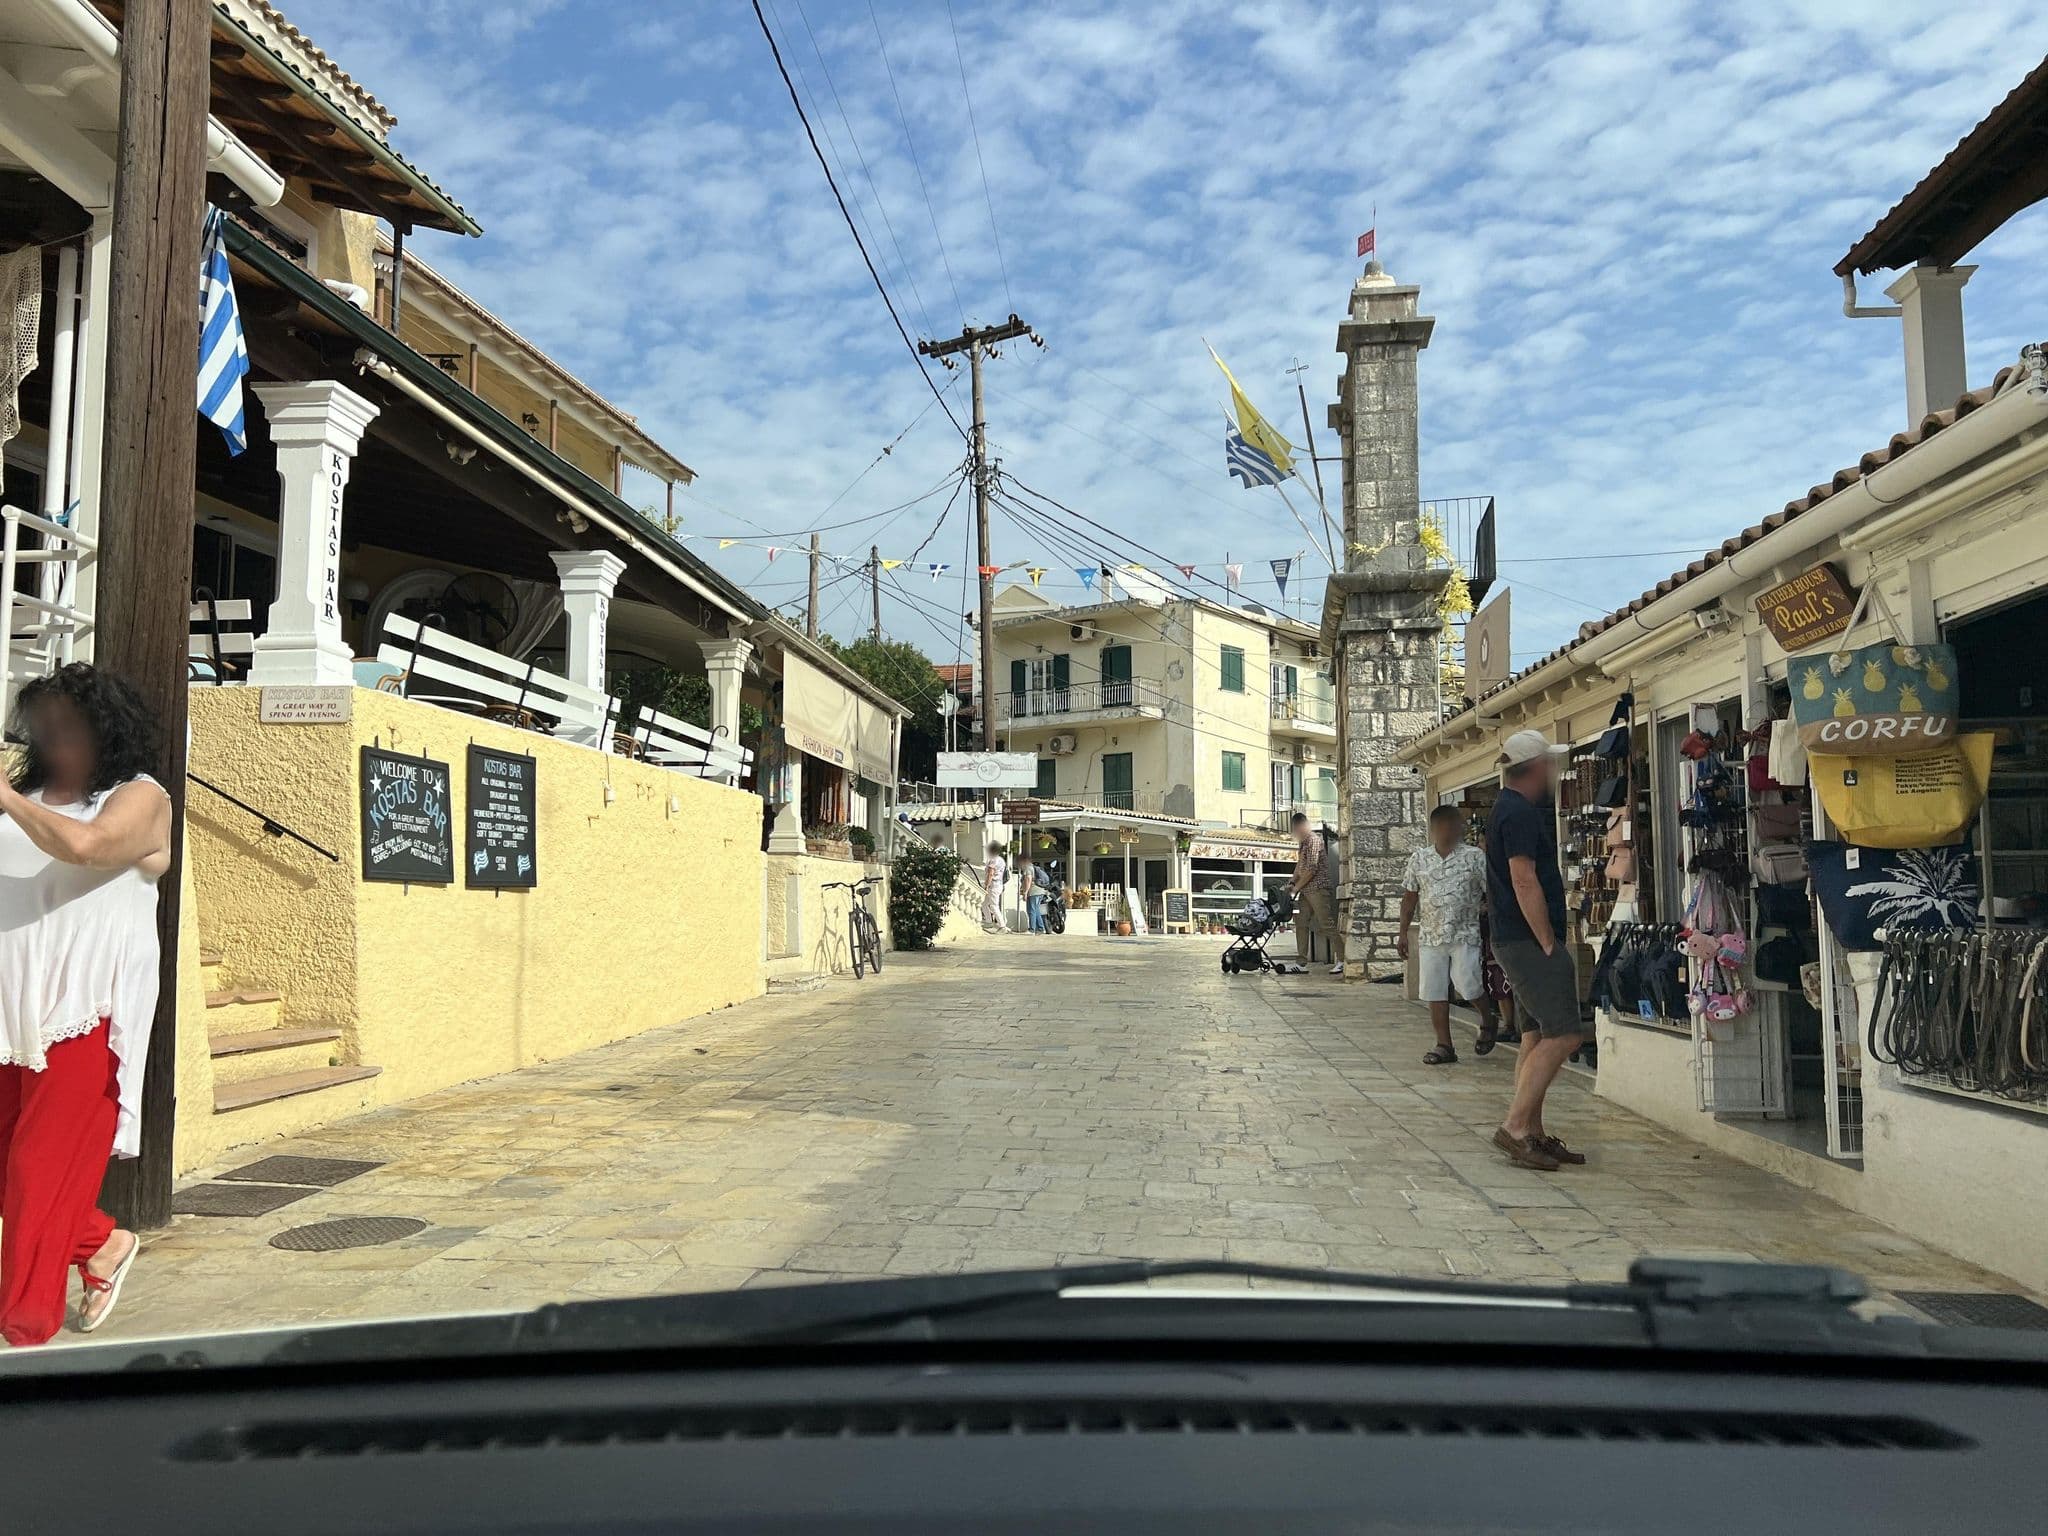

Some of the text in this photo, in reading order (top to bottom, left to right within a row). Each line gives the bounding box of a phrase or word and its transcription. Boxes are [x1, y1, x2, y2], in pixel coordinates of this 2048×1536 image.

[324, 453, 342, 619] KOSTAS BAR
[1757, 583, 1798, 611] LEATHER
[1793, 568, 1828, 595] HOUSE
[1775, 591, 1835, 632] Paul's
[1825, 613, 1852, 633] LEATHE
[267, 688, 345, 700] KOSTAS BAR
[1820, 716, 1948, 742] CORFU
[803, 734, 822, 755] FASHION
[380, 759, 434, 785] WELCOME TO
[483, 758, 522, 779] KOSTAS BAR
[369, 779, 448, 839] KOSTAS BAR
